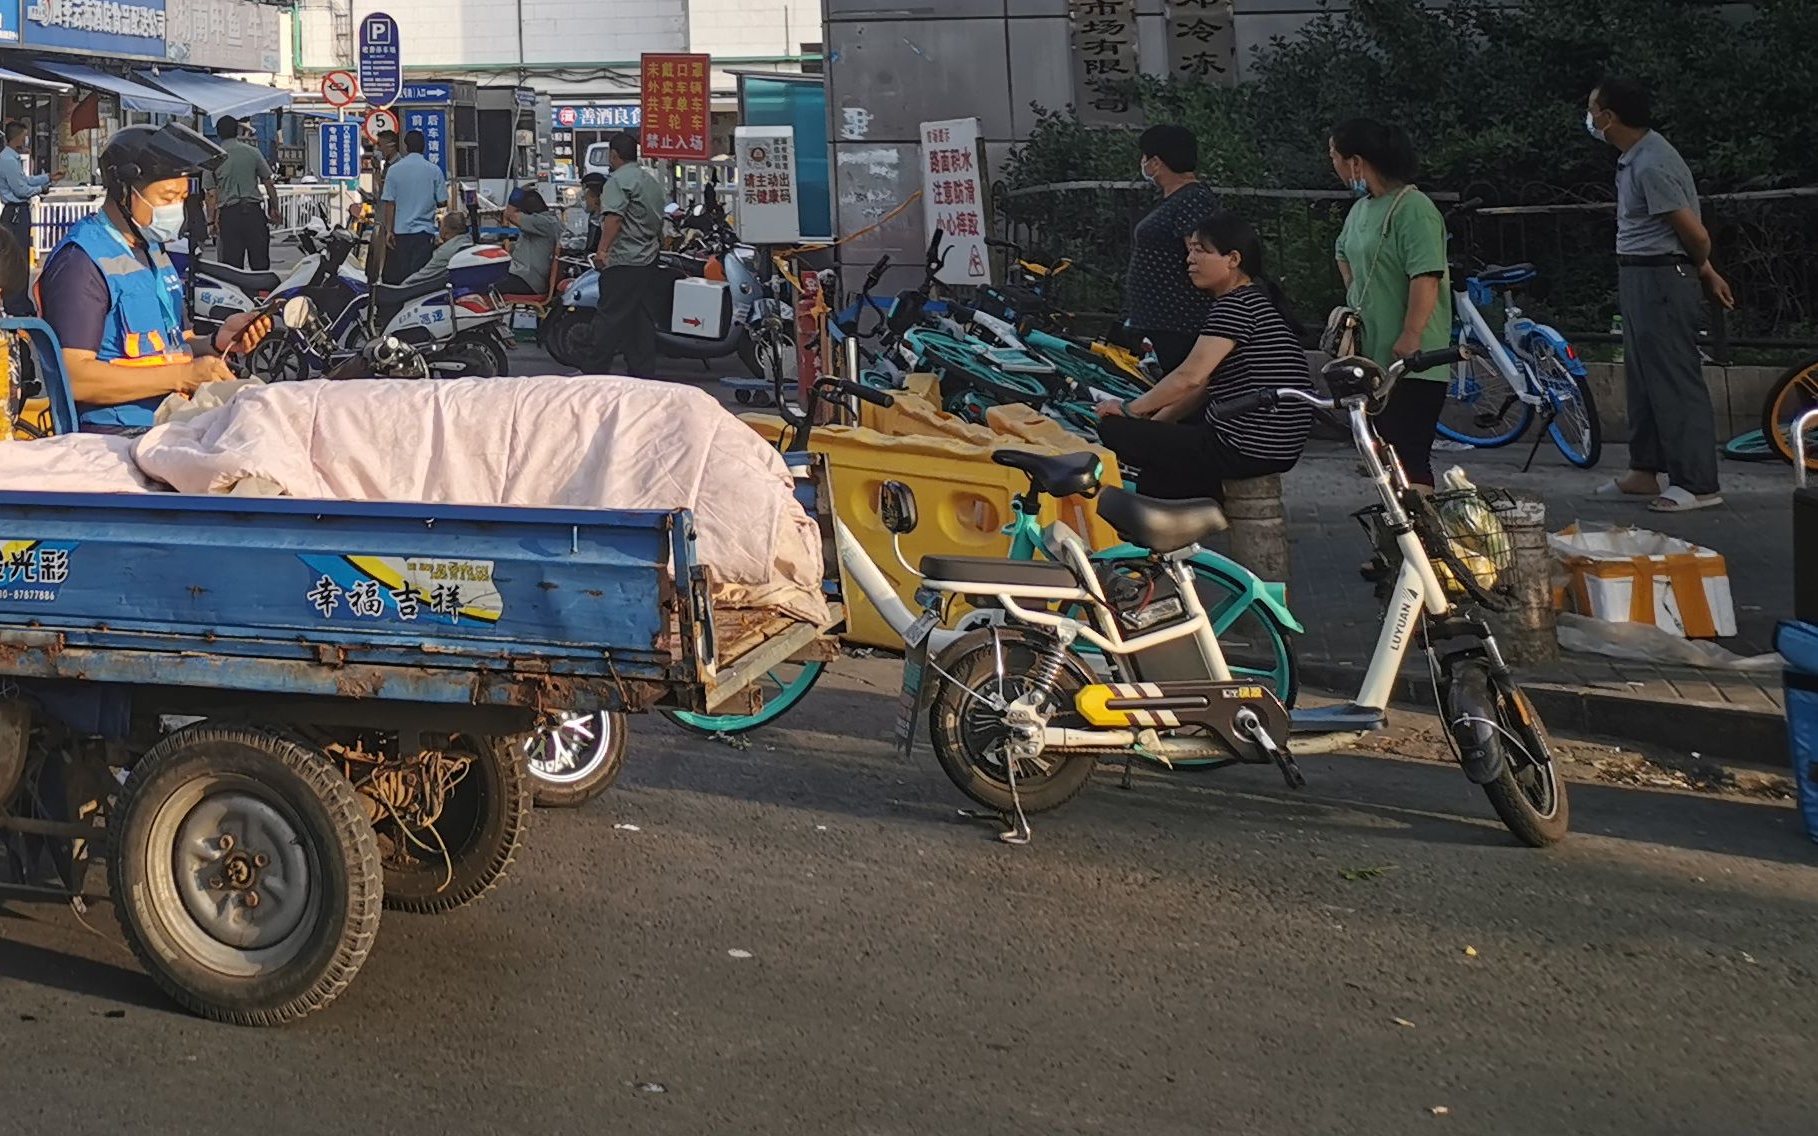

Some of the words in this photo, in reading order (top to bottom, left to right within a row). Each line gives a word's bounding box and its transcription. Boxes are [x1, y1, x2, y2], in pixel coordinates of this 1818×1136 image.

[371, 23, 386, 40] P
[647, 62, 703, 78] 未戴口罩
[647, 79, 703, 94] 外卖车辆
[647, 95, 703, 112] 共享单车
[375, 114, 386, 128] 5
[646, 113, 703, 130] 三轮车
[645, 133, 704, 151] 禁止入场
[929, 146, 974, 174] 路面积水
[744, 172, 790, 188] 请主动出
[744, 188, 792, 204] 示健康码
[932, 179, 976, 205] 注意防滑
[307, 573, 465, 625] 幸福吉祥
[1390, 602, 1412, 651] LUYUAN
